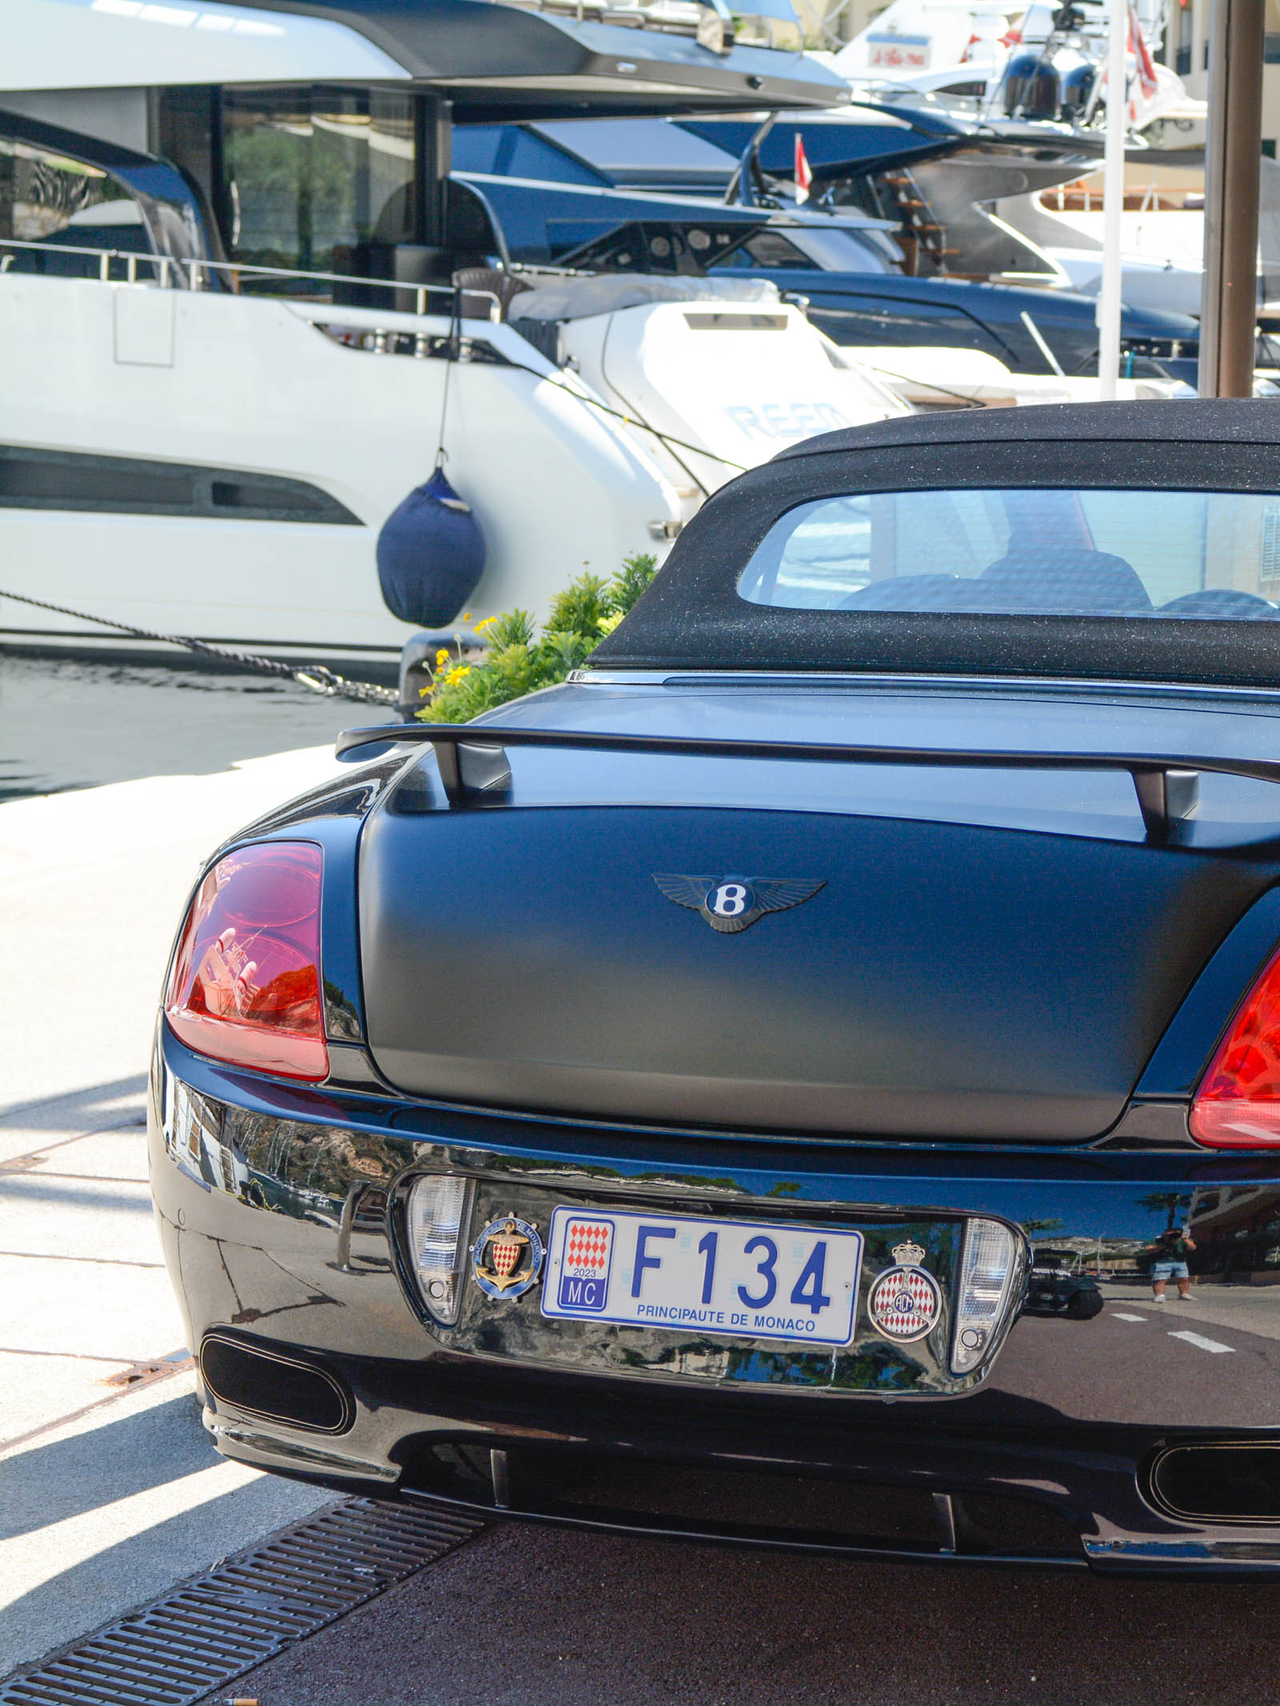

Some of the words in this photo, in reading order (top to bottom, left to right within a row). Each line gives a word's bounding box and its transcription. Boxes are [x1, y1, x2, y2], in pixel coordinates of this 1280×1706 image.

[573, 1267, 597, 1278] 2023
[567, 1281, 596, 1305] MC
[637, 1304, 725, 1324] PRINCIPAUTE
[731, 1313, 749, 1326] DE
[754, 1315, 816, 1333] MONACO
